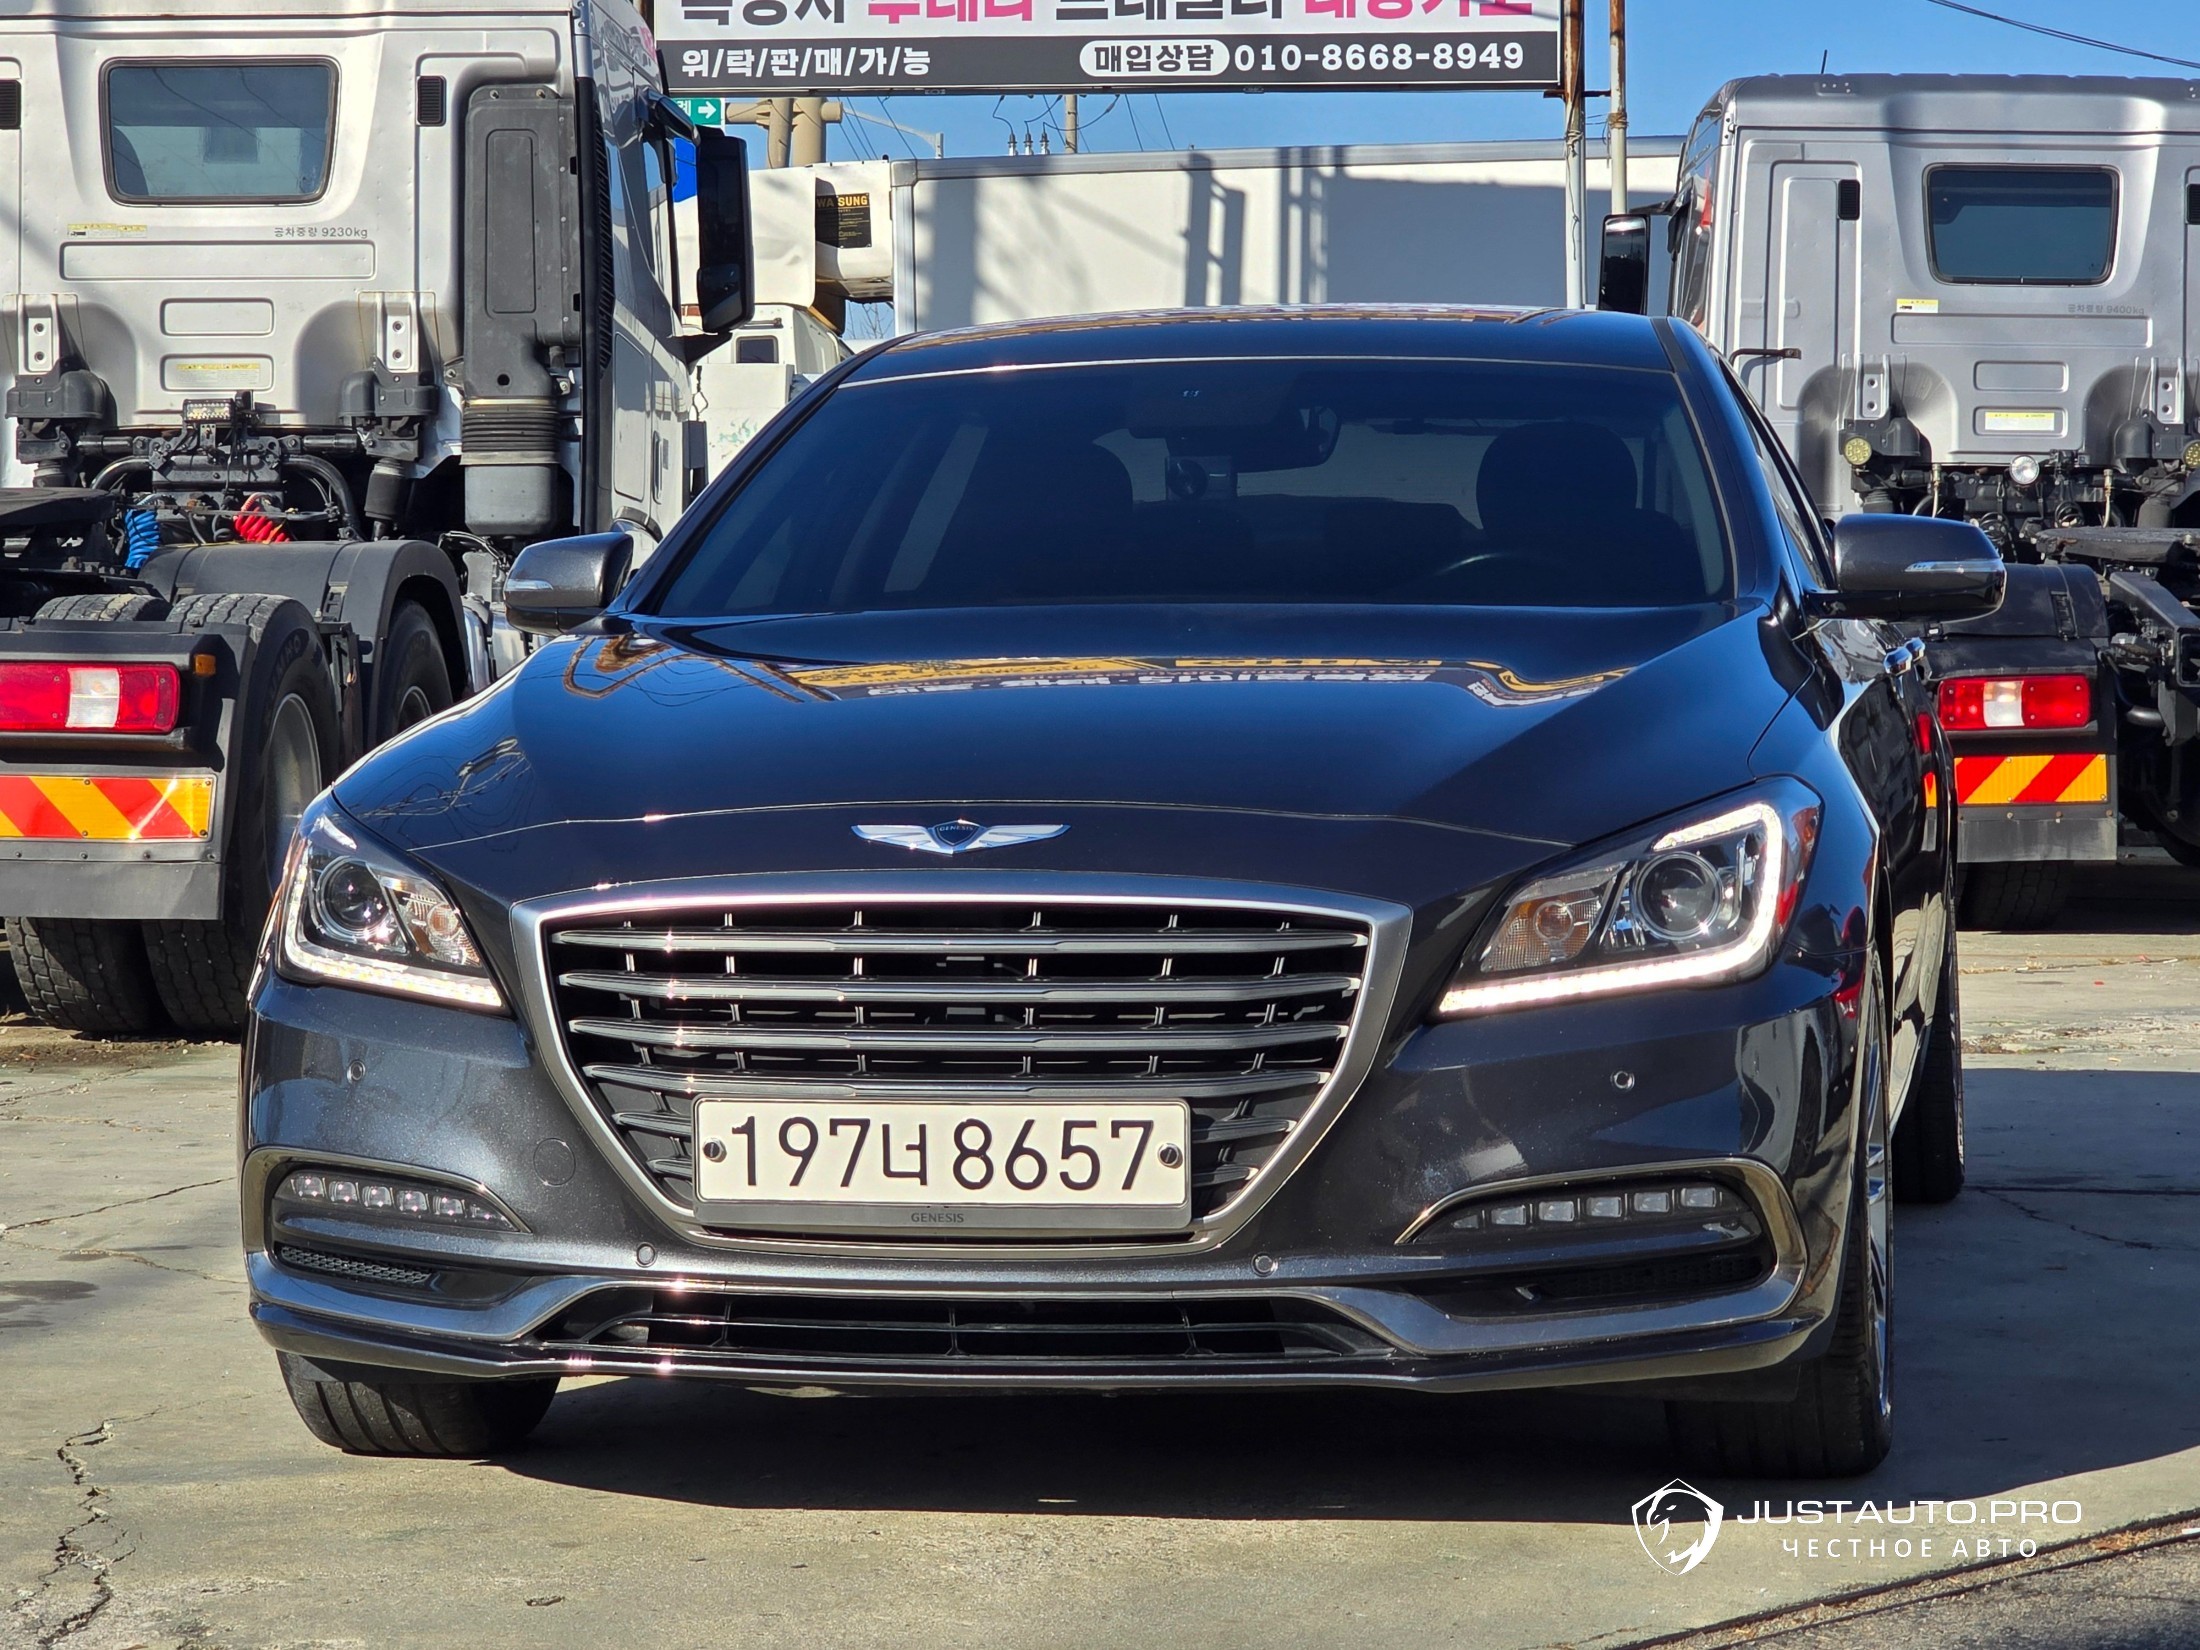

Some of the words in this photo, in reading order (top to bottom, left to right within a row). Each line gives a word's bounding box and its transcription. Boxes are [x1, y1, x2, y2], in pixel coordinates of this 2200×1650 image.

[682, 46, 931, 78] 위/탁/판/매/가/능
[1094, 44, 1214, 72] 매입상담
[1234, 42, 1524, 72] 010-8668-8949
[274, 226, 318, 238] 공차중량
[321, 227, 368, 239] 9230kg
[911, 1212, 965, 1223] GENESIS
